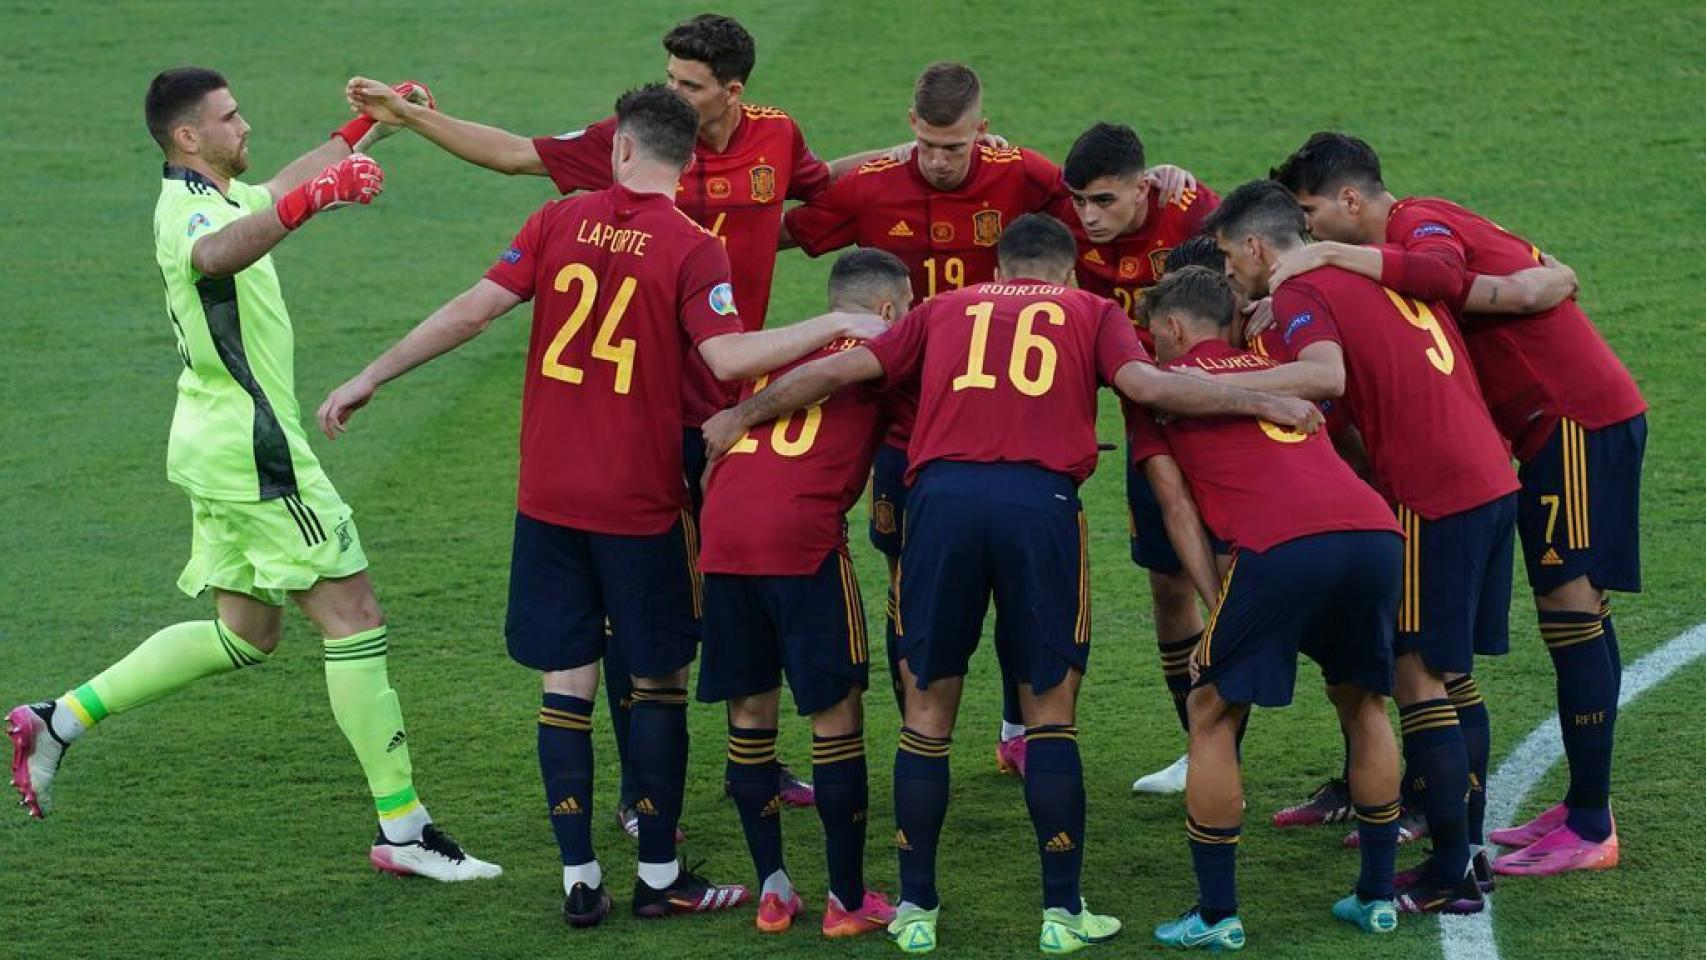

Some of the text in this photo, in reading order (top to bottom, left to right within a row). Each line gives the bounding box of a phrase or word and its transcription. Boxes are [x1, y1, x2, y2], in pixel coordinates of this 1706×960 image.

[577, 218, 653, 256] LAPORTE
[923, 257, 964, 303] 19
[977, 284, 1066, 296] RODRIGO
[541, 262, 638, 395] 24
[952, 301, 1066, 396] 16
[1540, 495, 1560, 545] 7
